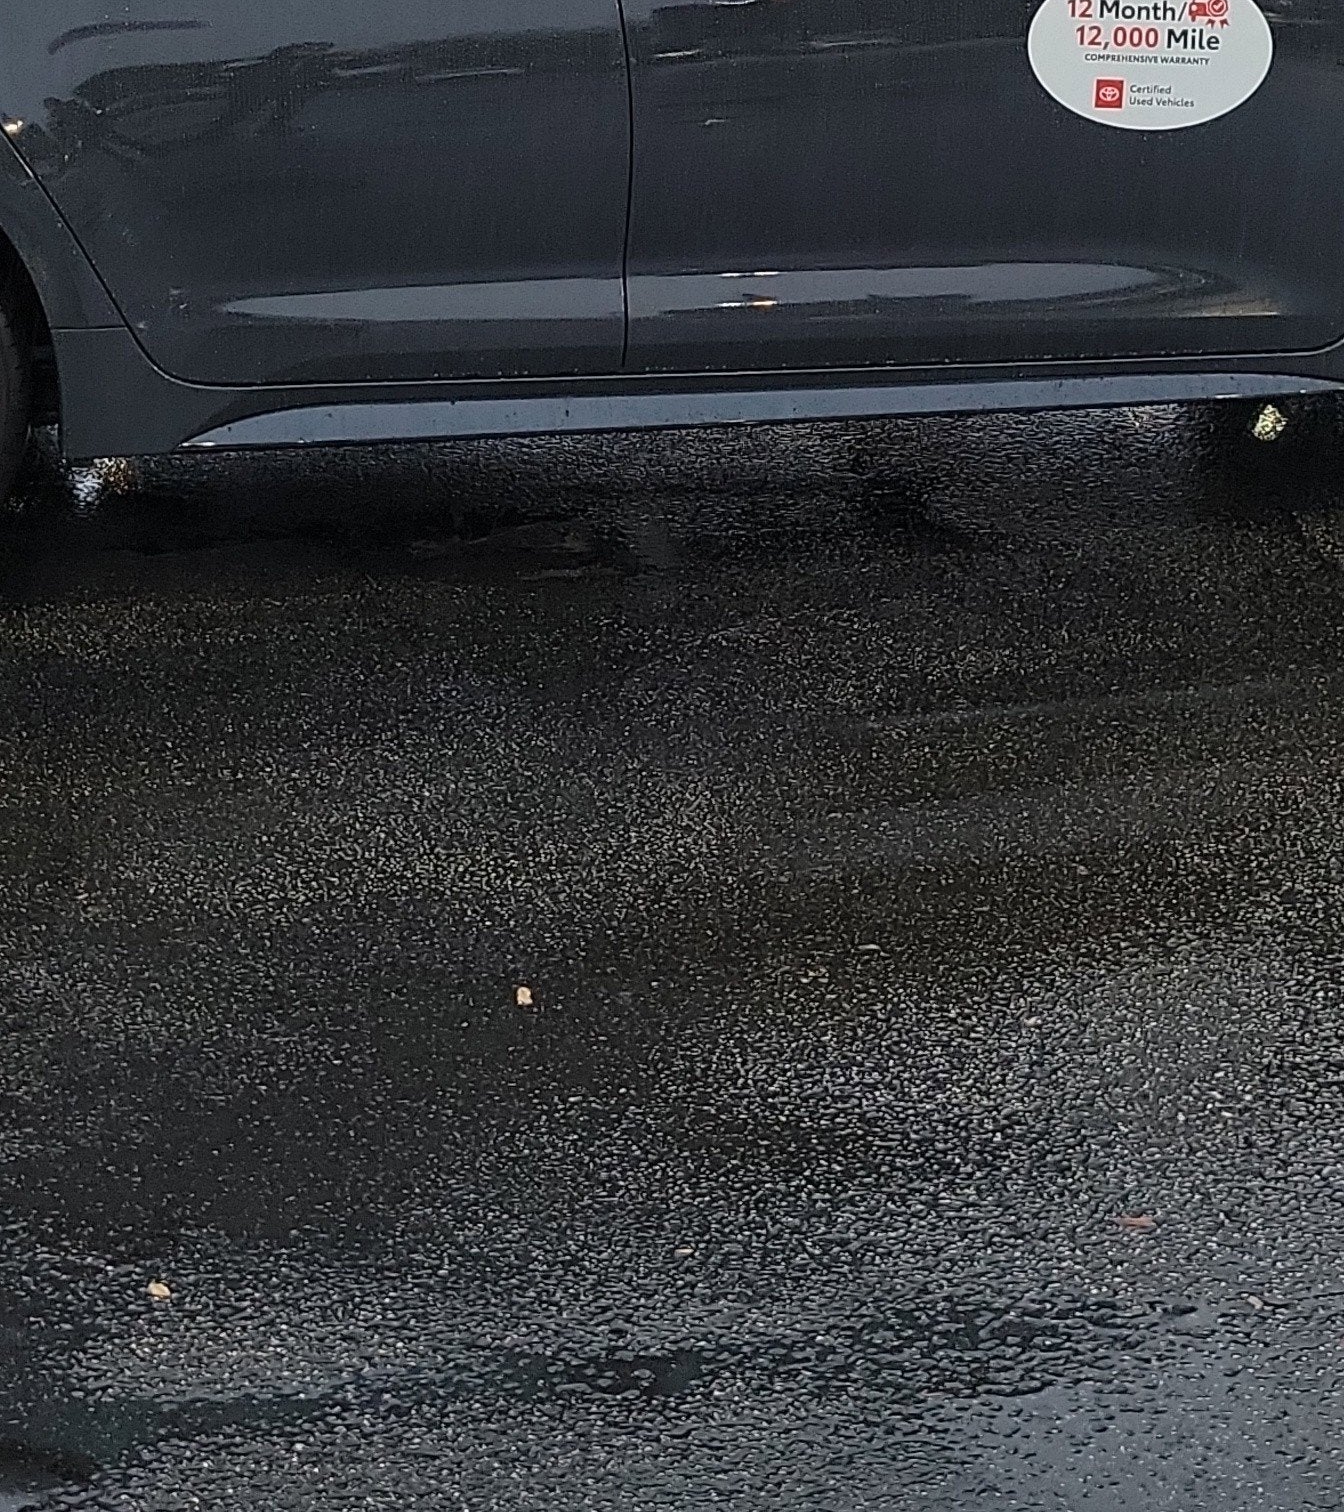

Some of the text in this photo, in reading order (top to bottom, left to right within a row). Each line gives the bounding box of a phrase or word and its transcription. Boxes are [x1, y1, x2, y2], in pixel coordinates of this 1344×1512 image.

[1075, 24, 1220, 51] 12,000 Mile
[1084, 53, 1210, 66] COMPREHENSIVE WARRANTY
[1129, 84, 1172, 94] Certified
[1129, 97, 1195, 108] Used Vehicles
